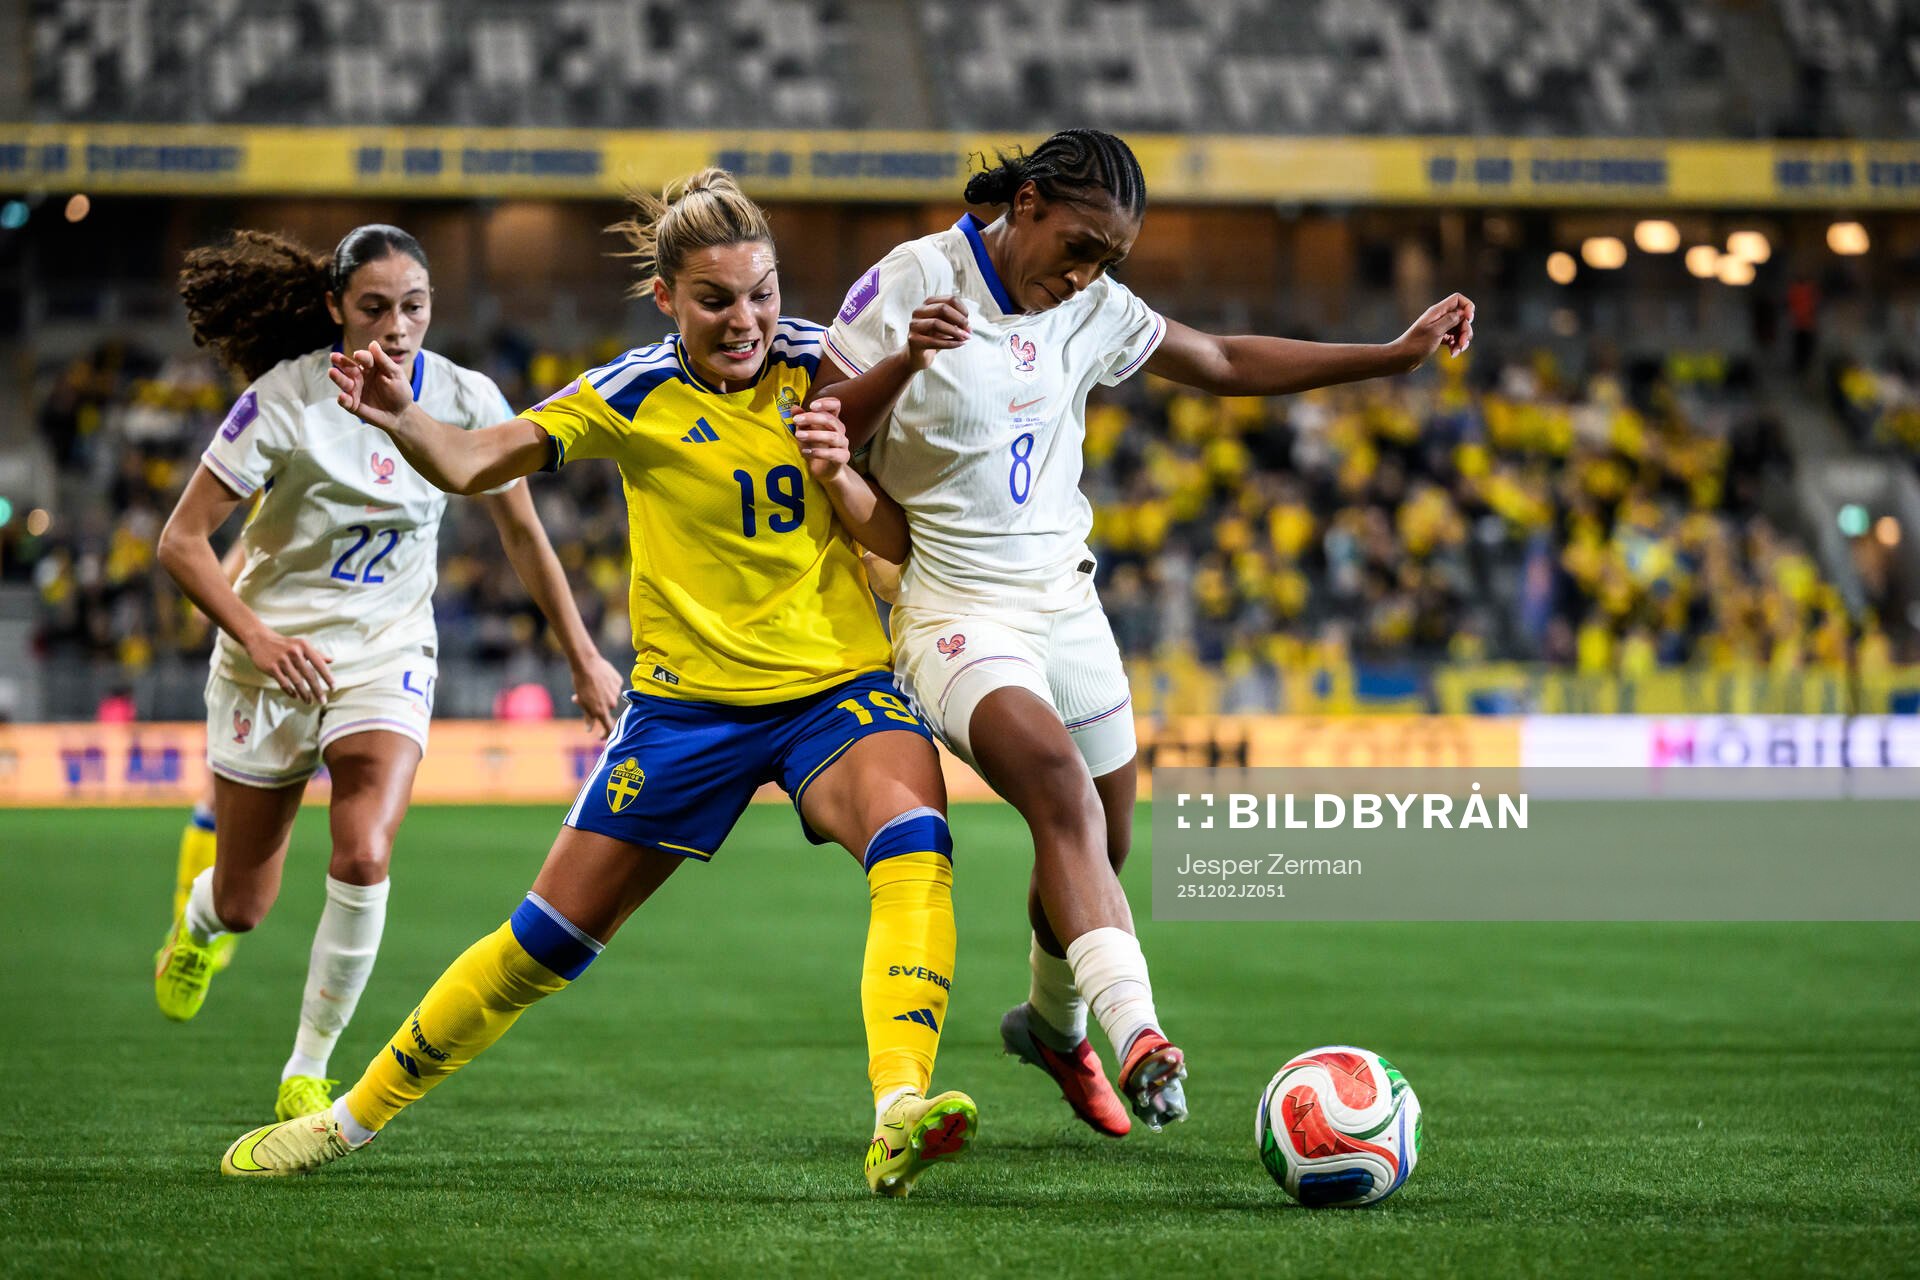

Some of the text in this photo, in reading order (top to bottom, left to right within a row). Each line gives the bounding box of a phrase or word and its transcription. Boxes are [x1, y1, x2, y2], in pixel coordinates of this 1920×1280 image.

[1009, 432, 1035, 504] 8
[733, 464, 805, 538] 19
[330, 524, 399, 583] 22
[836, 690, 920, 726] 19
[888, 965, 952, 993] SVERIG
